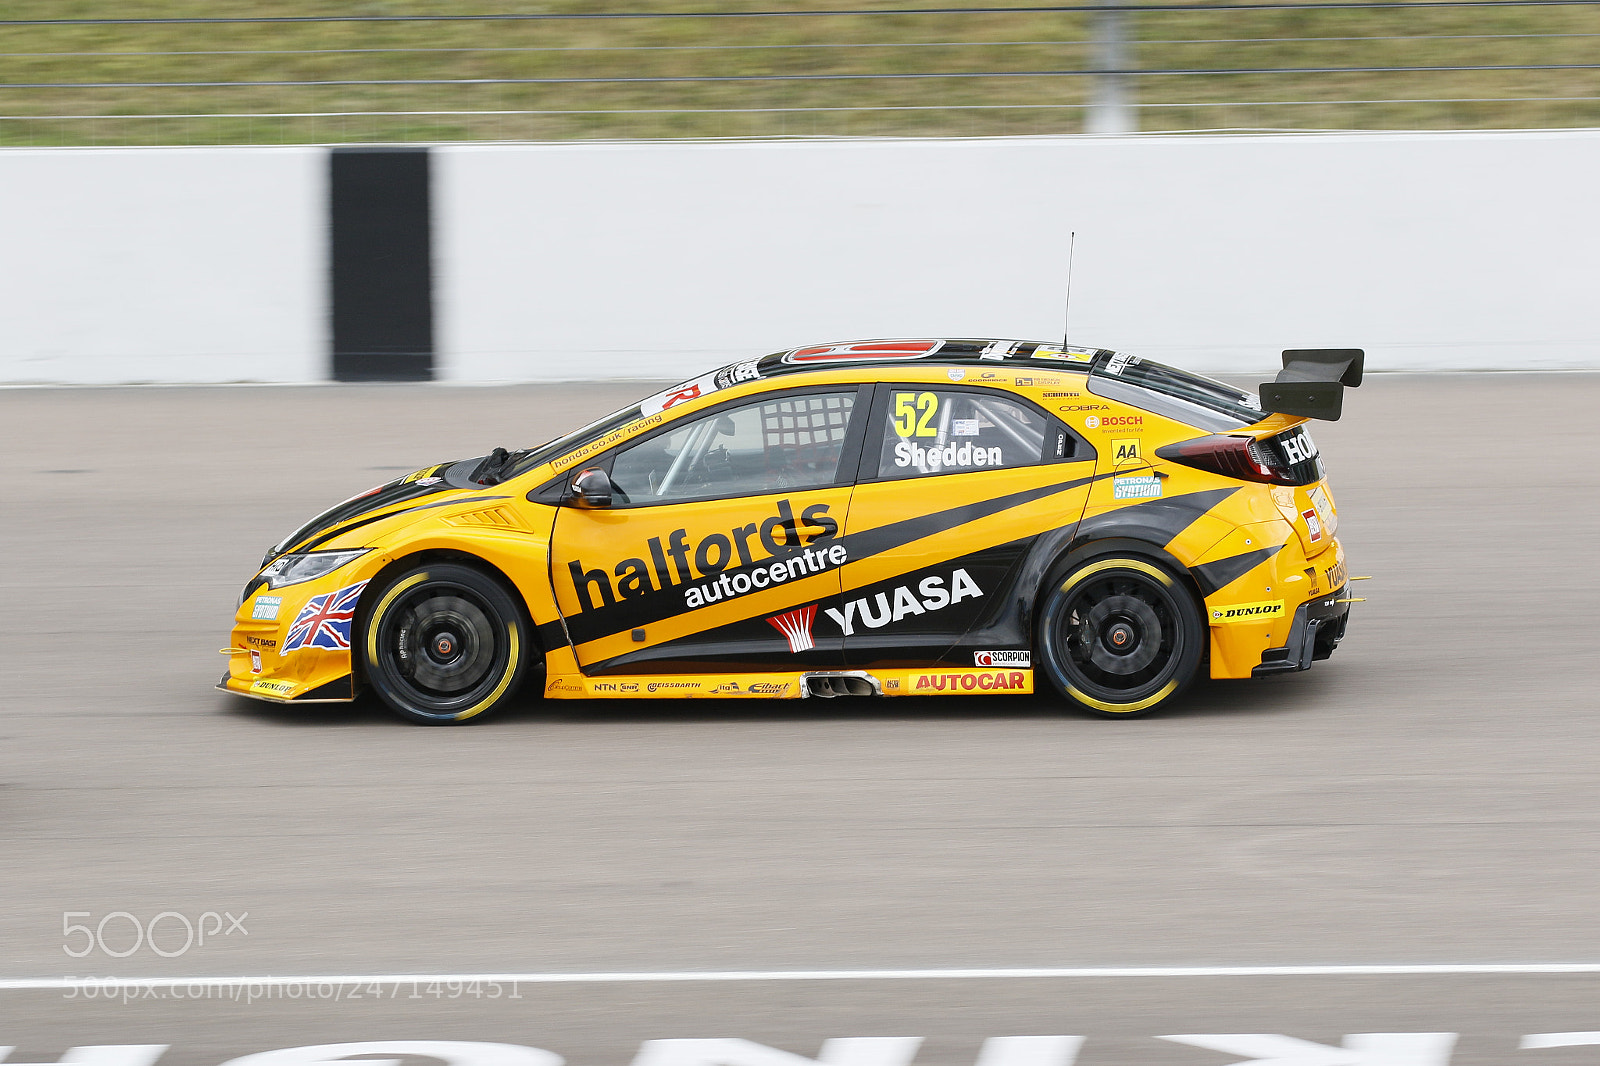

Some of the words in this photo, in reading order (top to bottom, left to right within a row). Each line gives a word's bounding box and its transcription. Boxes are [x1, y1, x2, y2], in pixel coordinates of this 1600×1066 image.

[894, 391, 938, 437] 52
[1101, 416, 1143, 425] BOSCH
[554, 413, 663, 469] honda.co.uk/racing
[894, 441, 1004, 467] Shedden
[1116, 444, 1137, 459] AA
[1114, 476, 1160, 485] PETRONAS
[1114, 484, 1161, 498] SYNTIUM
[568, 499, 839, 614] halfords
[684, 543, 848, 609] autocentre
[824, 567, 984, 637] YUASA
[1225, 604, 1281, 618] DUNLOP
[992, 651, 1030, 662] SCORPION
[259, 681, 292, 693] DUNLOP
[594, 683, 617, 692] NTN
[916, 671, 1025, 691] AUTOCAR
